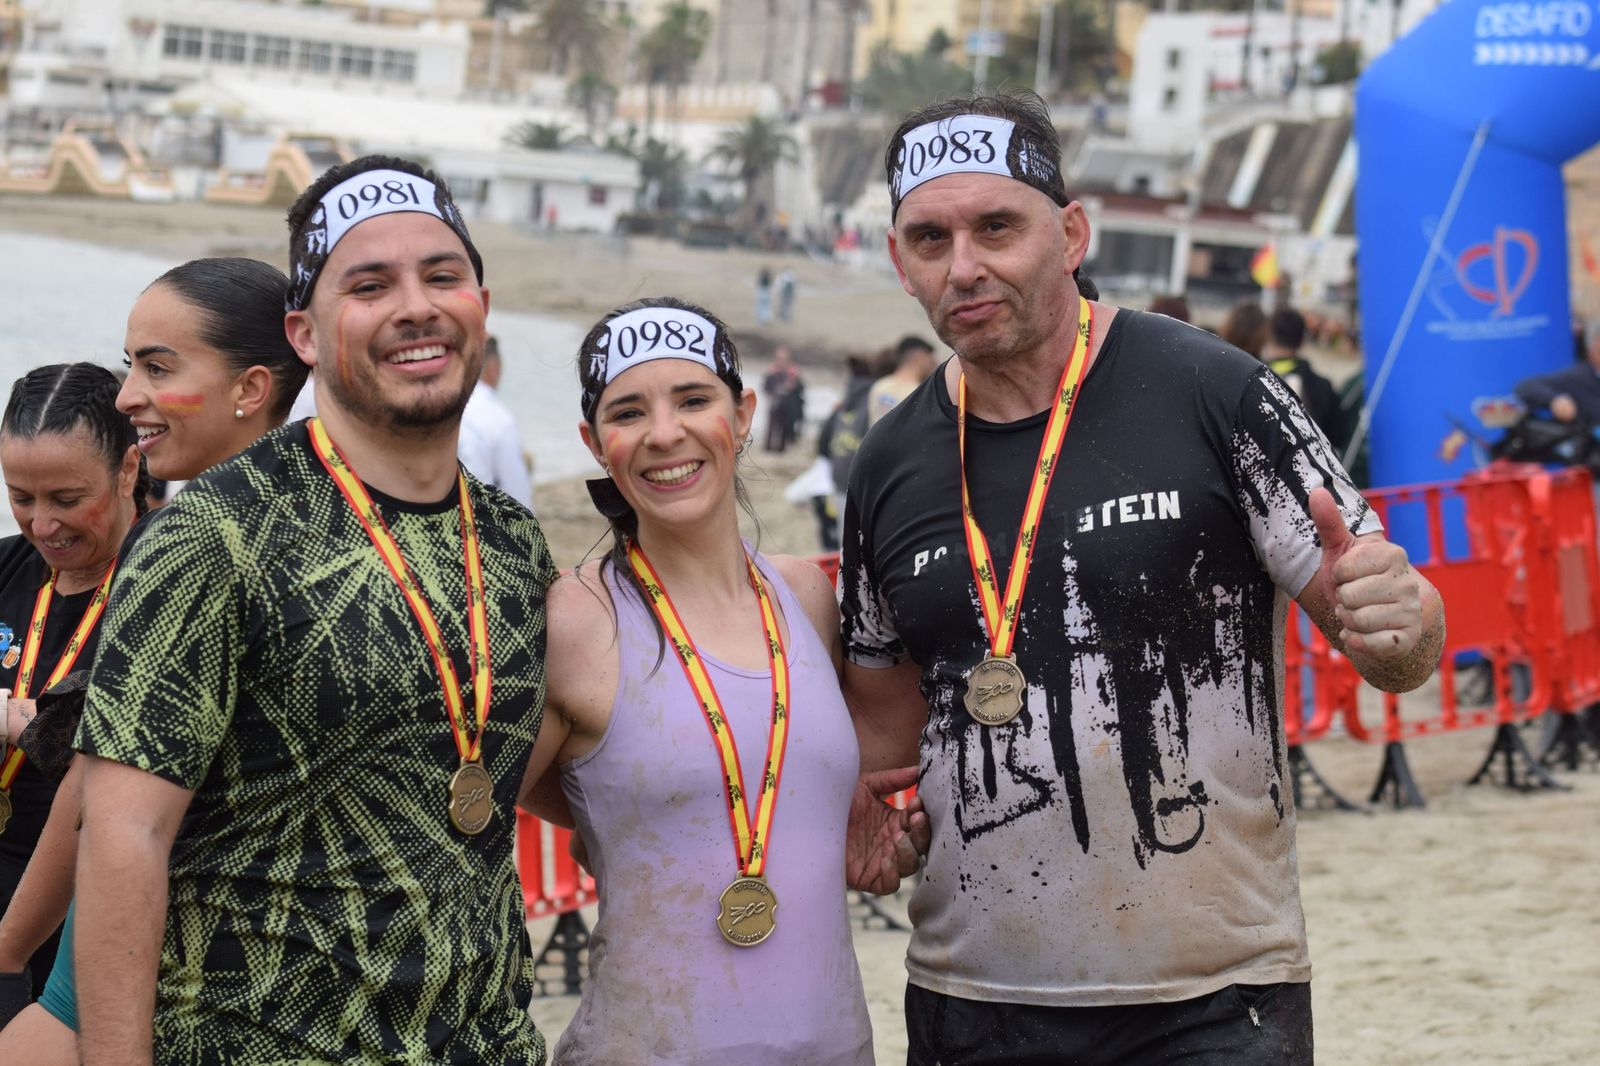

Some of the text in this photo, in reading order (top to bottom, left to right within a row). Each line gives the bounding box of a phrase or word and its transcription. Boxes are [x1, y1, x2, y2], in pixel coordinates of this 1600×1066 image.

[909, 129, 996, 177] 0983
[1030, 166, 1049, 182] 300
[338, 180, 420, 220] 0981
[617, 310, 707, 359] 0982
